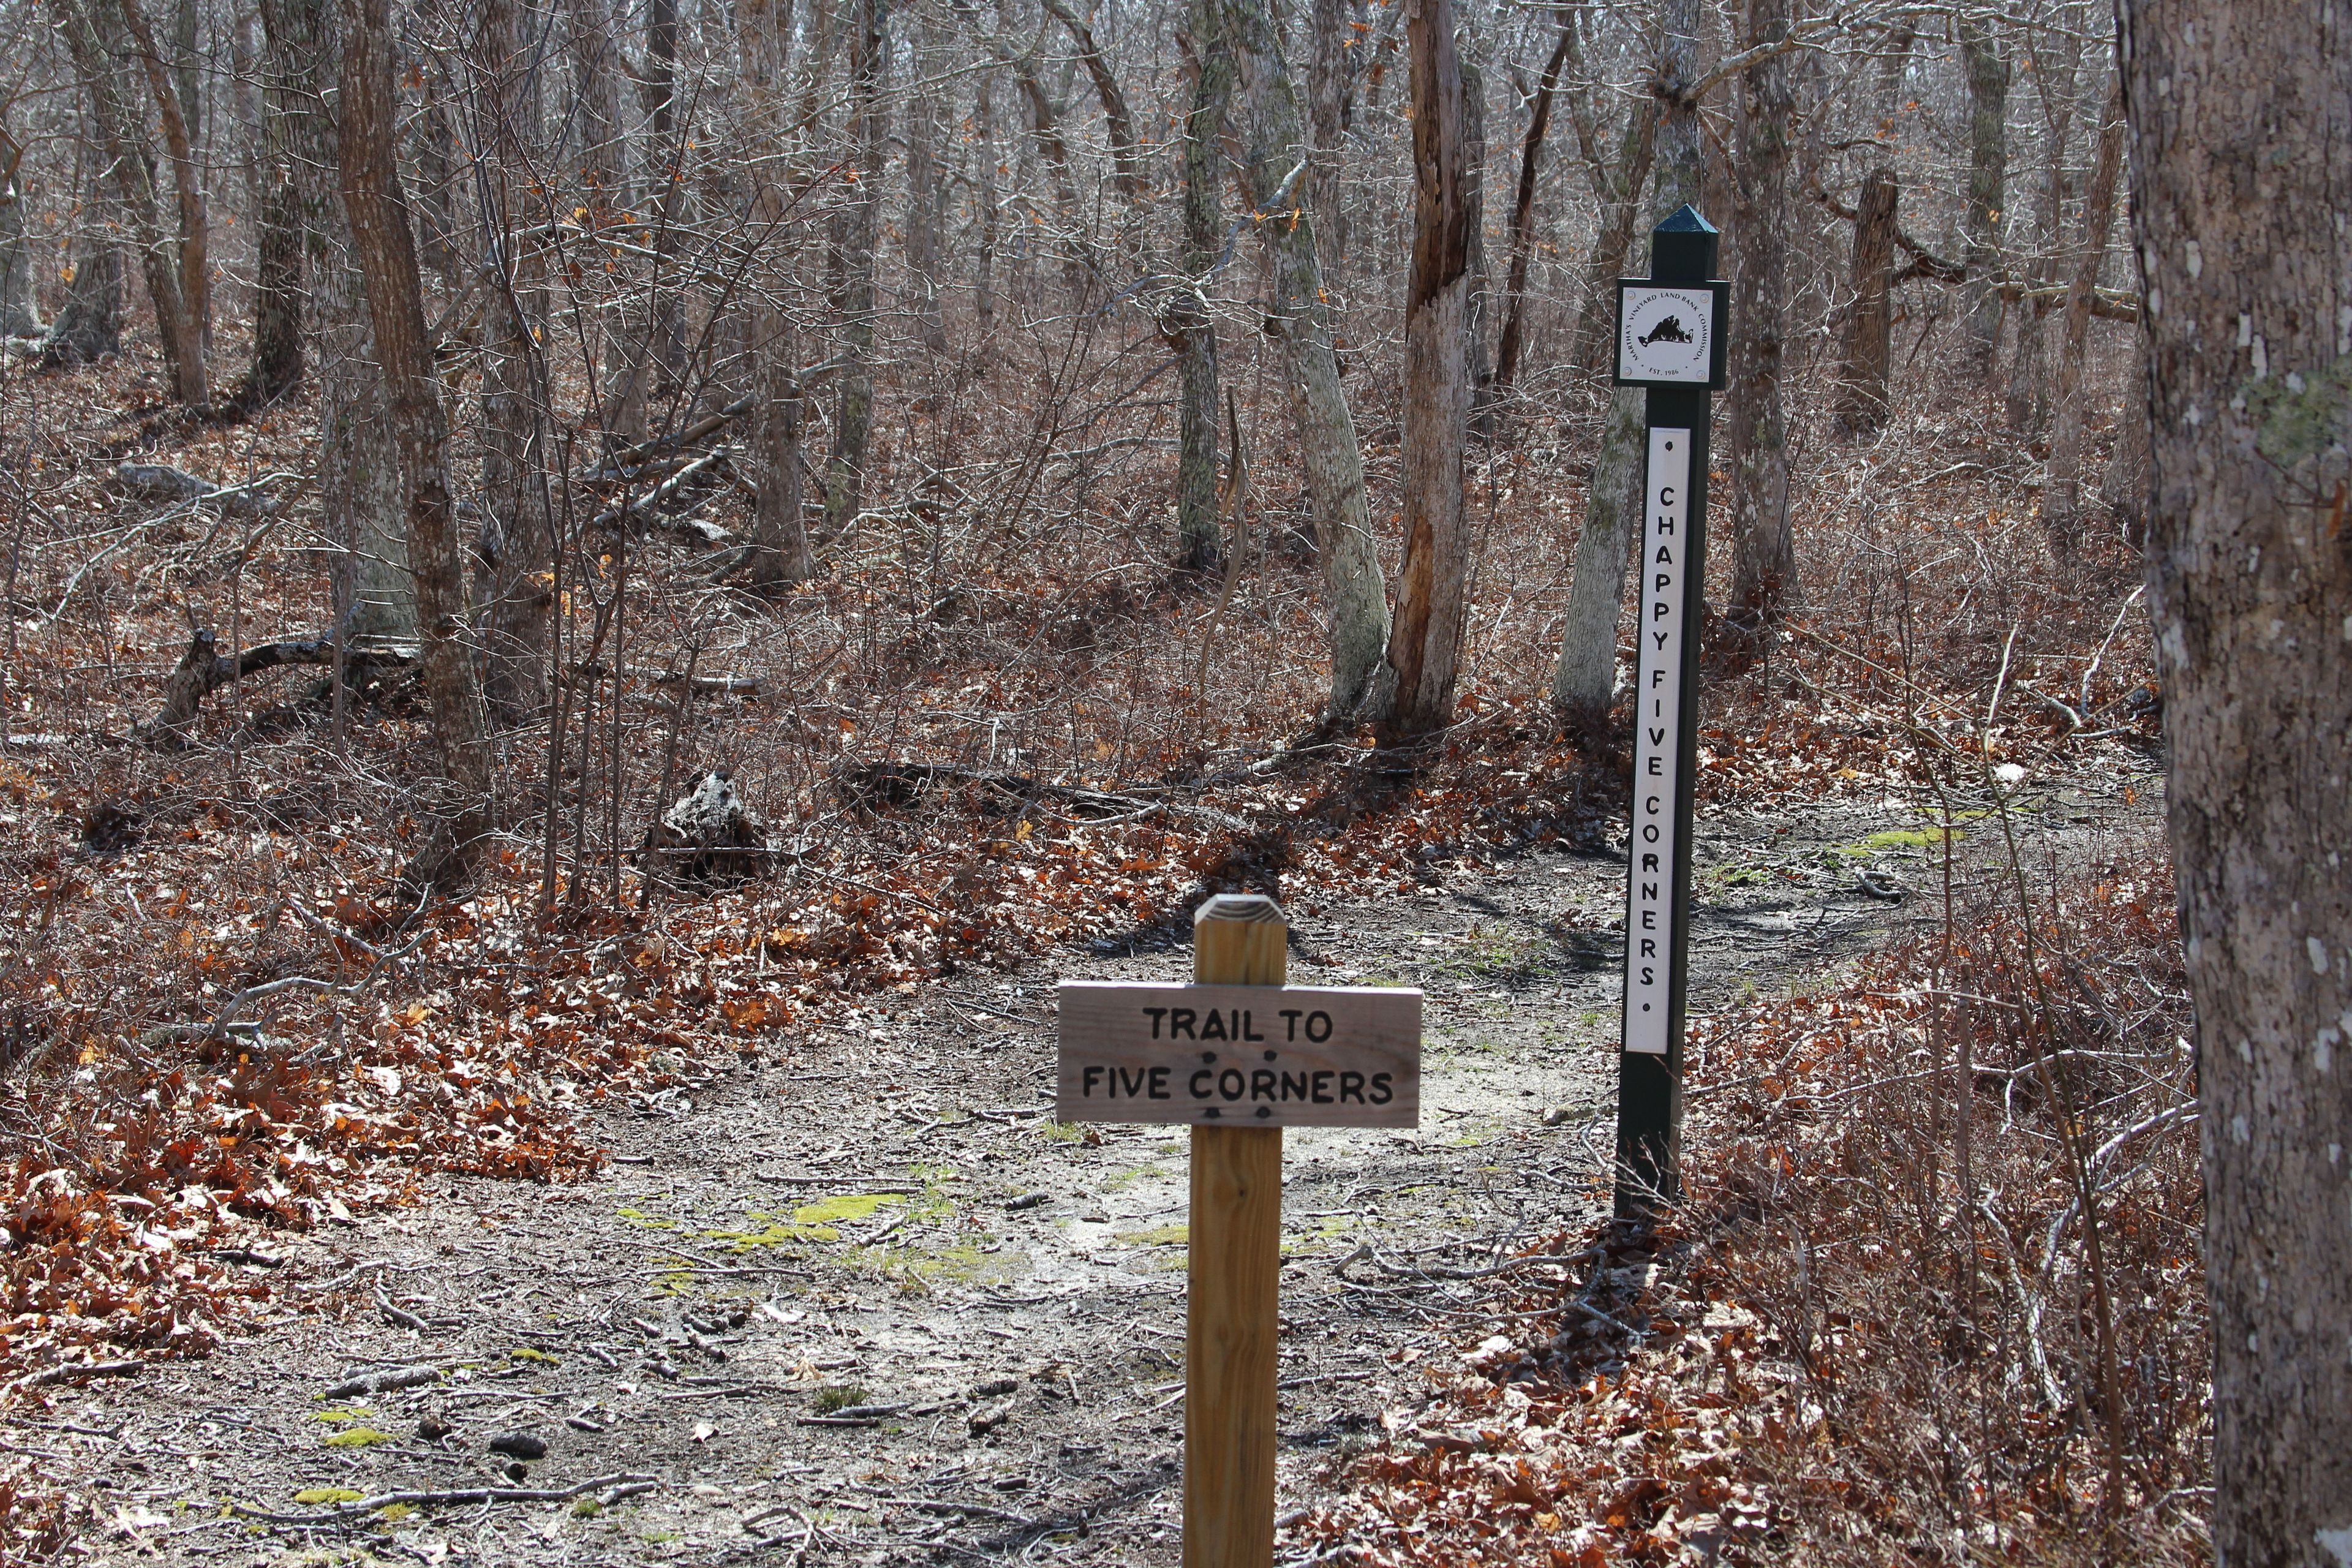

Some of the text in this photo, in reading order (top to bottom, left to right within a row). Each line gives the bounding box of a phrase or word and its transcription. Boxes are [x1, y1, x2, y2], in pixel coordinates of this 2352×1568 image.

[1629, 294, 1657, 321] VINEYARD
[1681, 296, 1699, 311] BANK
[1626, 324, 1640, 361] MARTHA'S
[1693, 314, 1708, 362] COMMISSION
[1640, 487, 1675, 986] CHAPPY FIVE CORNERS
[1142, 1006, 1333, 1044] TRAIL TO
[1082, 1065, 1394, 1105] FIVE CORNERS
